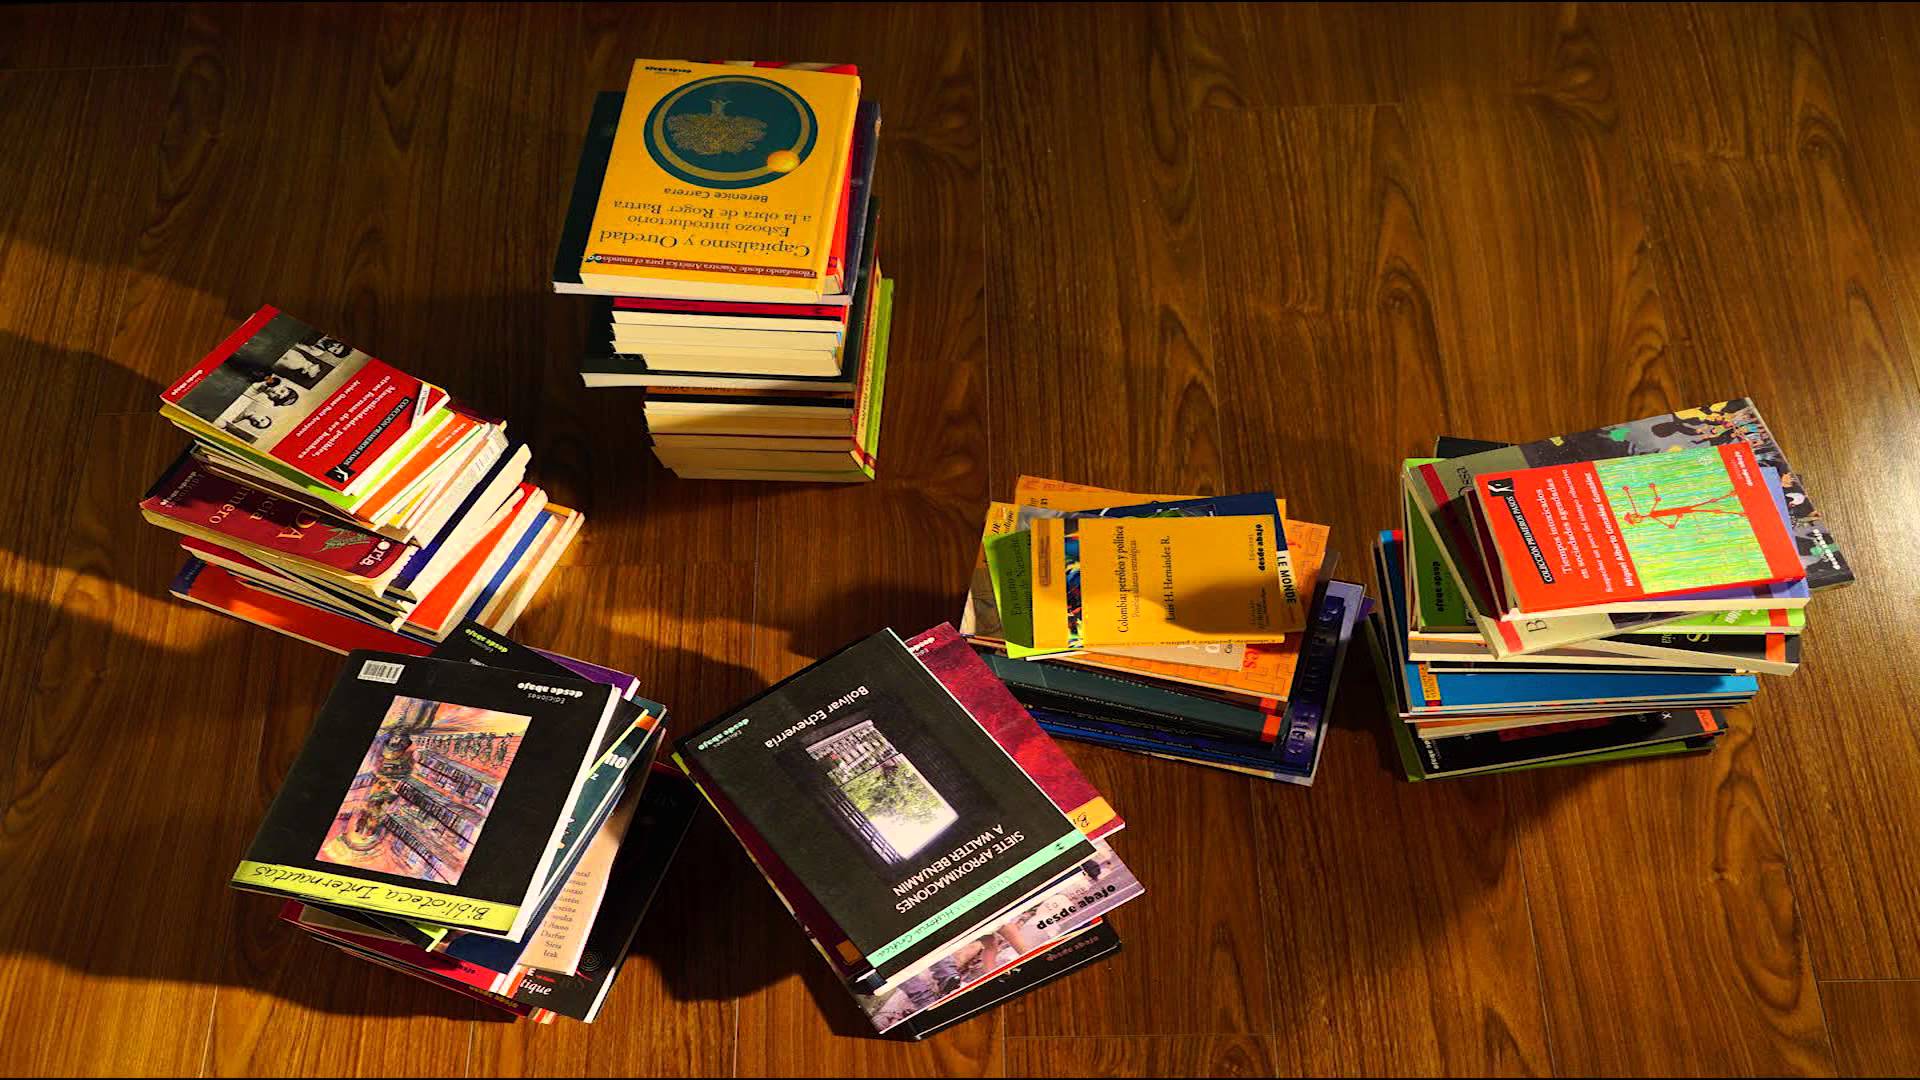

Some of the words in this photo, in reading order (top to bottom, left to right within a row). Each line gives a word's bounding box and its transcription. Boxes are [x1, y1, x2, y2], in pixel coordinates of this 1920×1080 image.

[664, 187, 711, 199] Carrera
[714, 191, 768, 202] Berenice
[613, 199, 661, 214] Bartra
[667, 203, 715, 217] Roger
[720, 207, 738, 217] de
[745, 208, 779, 220] obra
[783, 210, 797, 221] la
[627, 214, 732, 230] introductorio
[735, 222, 791, 237] Esbozo
[600, 229, 678, 248] Otredad
[684, 234, 694, 246] y
[701, 237, 810, 257] Capitalismo
[603, 256, 634, 266] mundo
[636, 258, 644, 267] el
[647, 259, 665, 268] para
[667, 260, 702, 270] América
[704, 263, 738, 273] Nuestra
[371, 374, 392, 393] otras
[329, 392, 346, 407] Omar
[347, 390, 373, 414] formas
[338, 411, 349, 423] de
[380, 396, 410, 428] COLECCIÓN
[327, 420, 340, 433] ser
[296, 431, 329, 460] hombres
[357, 424, 383, 452] PRIMEROS
[343, 448, 359, 466] PASOS
[1509, 494, 1521, 515] PASOS
[1545, 476, 1569, 521] agendadas
[1536, 487, 1558, 535] intoxicados
[1112, 525, 1126, 553] política
[1254, 523, 1264, 545] abajo
[1517, 513, 1535, 545] PRIMEROS
[1160, 535, 1170, 544] R.
[1563, 520, 1584, 566] sociedades
[1609, 533, 1624, 562] Alberto
[1256, 548, 1265, 570] desde
[1276, 555, 1287, 568] LE
[1531, 545, 1551, 583] COLECCIÓN
[1552, 534, 1570, 575] Tiempos
[1114, 561, 1128, 592] petróleo
[1160, 546, 1173, 589] Hernández
[1580, 566, 1589, 579] en
[1618, 559, 1632, 588] Miguel
[1163, 591, 1173, 601] H.
[1279, 568, 1296, 605] MONDE
[1116, 593, 1129, 632] Colombia:
[484, 637, 508, 654] desde
[516, 681, 549, 693] abajo
[549, 686, 583, 698] desde
[825, 683, 869, 714] Bolívar
[721, 717, 750, 736] desde
[763, 707, 828, 751] Echeverría
[696, 732, 724, 752] abajo
[991, 823, 1005, 838] A
[948, 828, 995, 864] WALTER
[991, 828, 1025, 857] SIETE
[253, 864, 379, 900] Internautas
[891, 855, 951, 897] BENJAMIN
[893, 847, 994, 915] APROXIMACIONES
[383, 887, 490, 921] Biblioteca
[1035, 902, 1077, 931] desde
[1076, 881, 1117, 909] abajo
